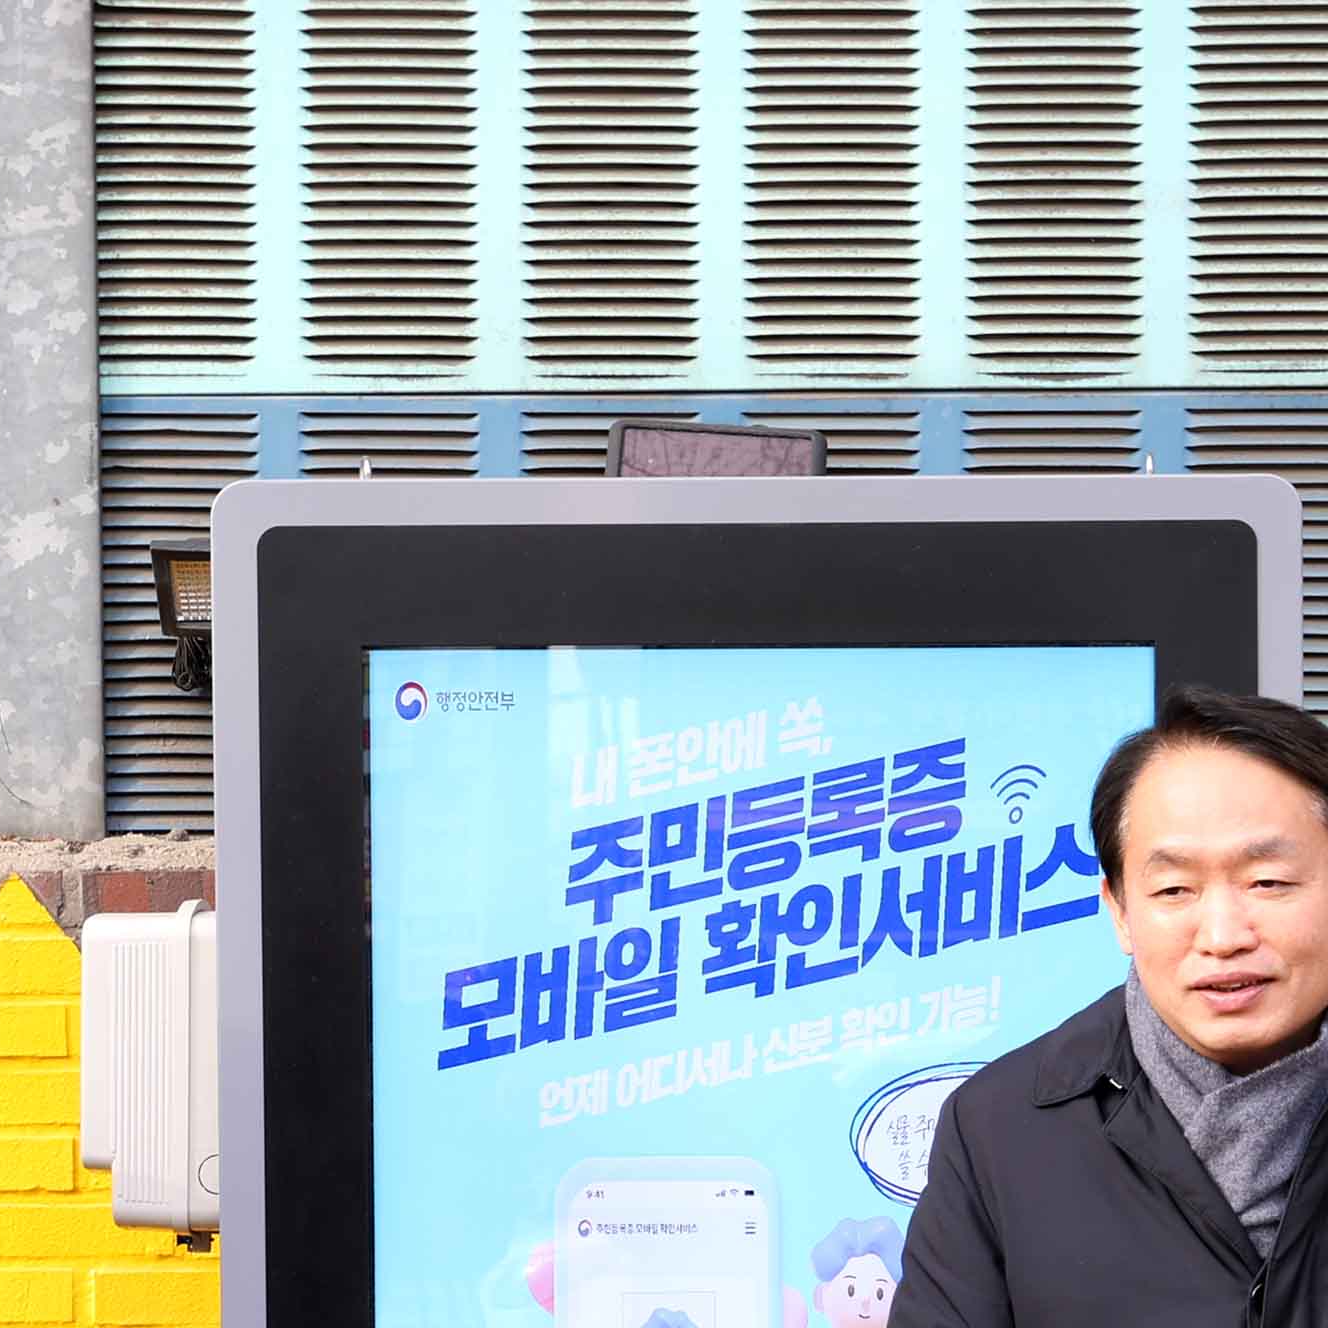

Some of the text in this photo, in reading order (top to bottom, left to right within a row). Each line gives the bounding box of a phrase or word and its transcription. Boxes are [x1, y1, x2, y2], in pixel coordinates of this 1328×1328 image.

[435, 690, 515, 712] 행정안전부
[571, 695, 833, 809] 내 폰안에 쏙,
[566, 736, 966, 926] 주민등록증
[438, 823, 1100, 1071] 모바일 확인서비스
[538, 975, 1001, 1128] 언제 어디서나 신분 확인 가능!
